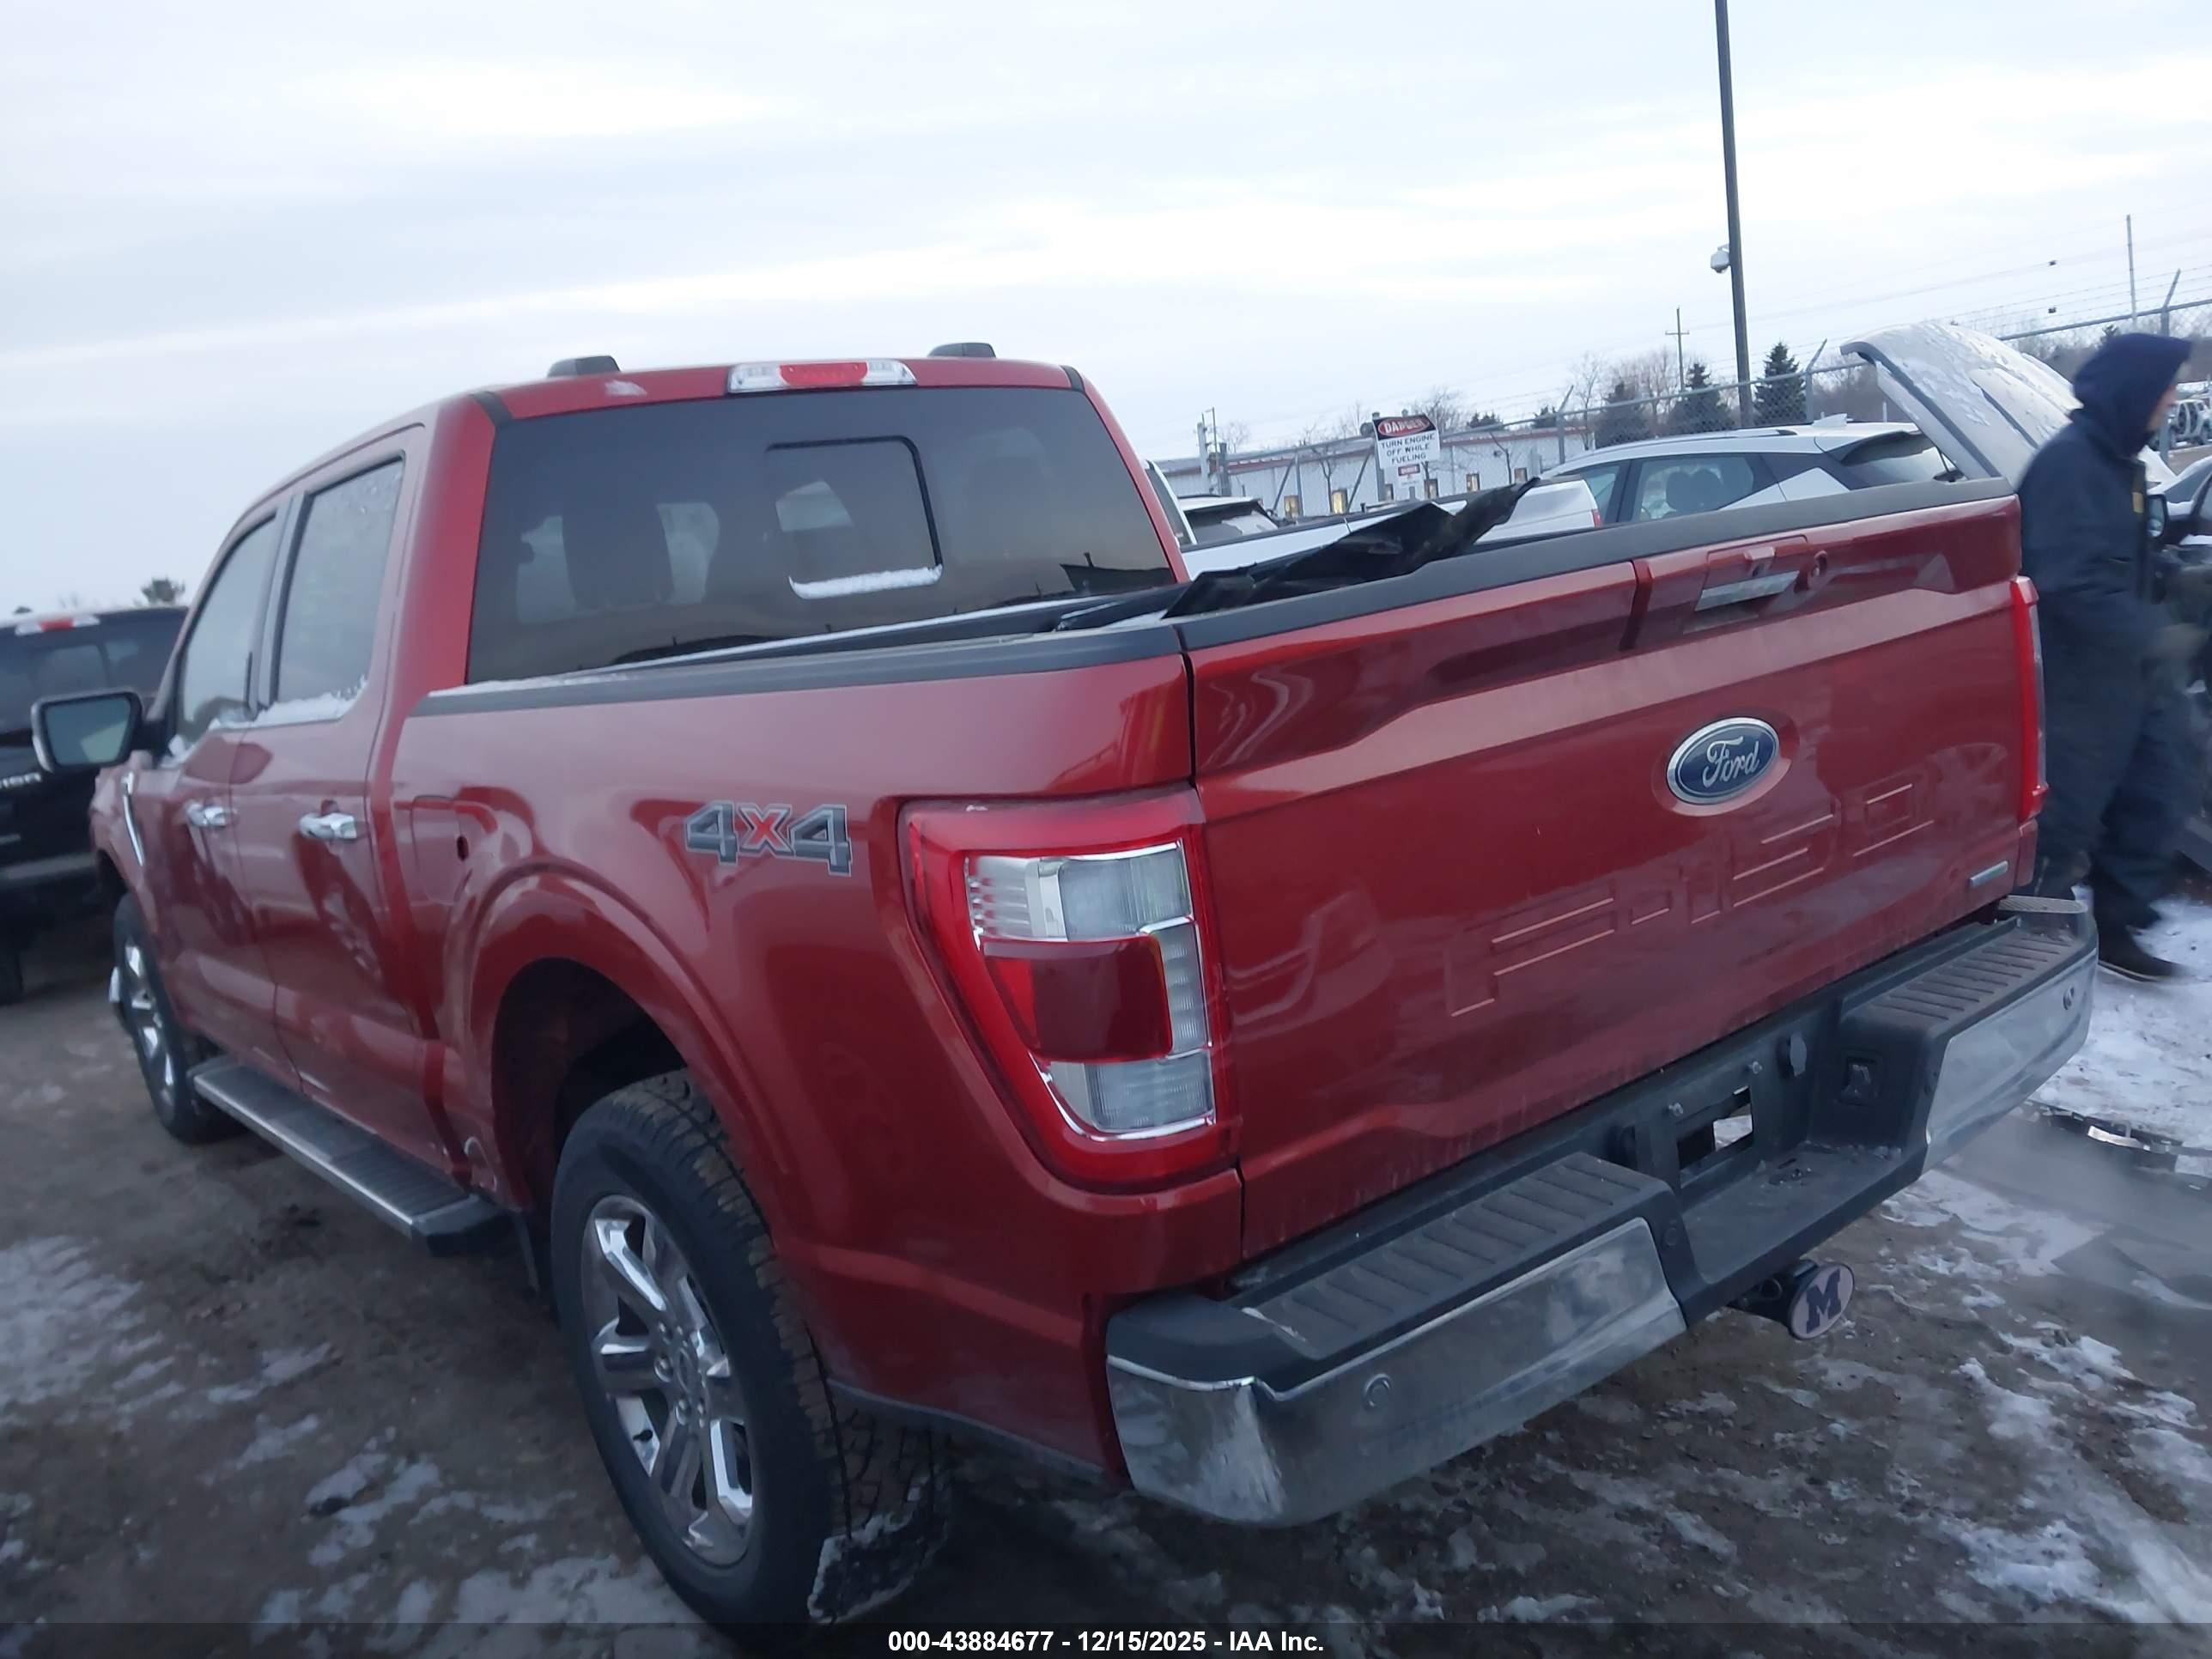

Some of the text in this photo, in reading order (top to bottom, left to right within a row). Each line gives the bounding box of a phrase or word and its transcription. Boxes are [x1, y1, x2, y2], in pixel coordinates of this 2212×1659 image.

[1382, 434, 1434, 449] TURN ENGINE
[1387, 443, 1429, 457] OFF WHILE
[1392, 453, 1426, 464] FUELING
[1702, 736, 1759, 787] Ford
[1806, 1268, 1841, 1334] M
